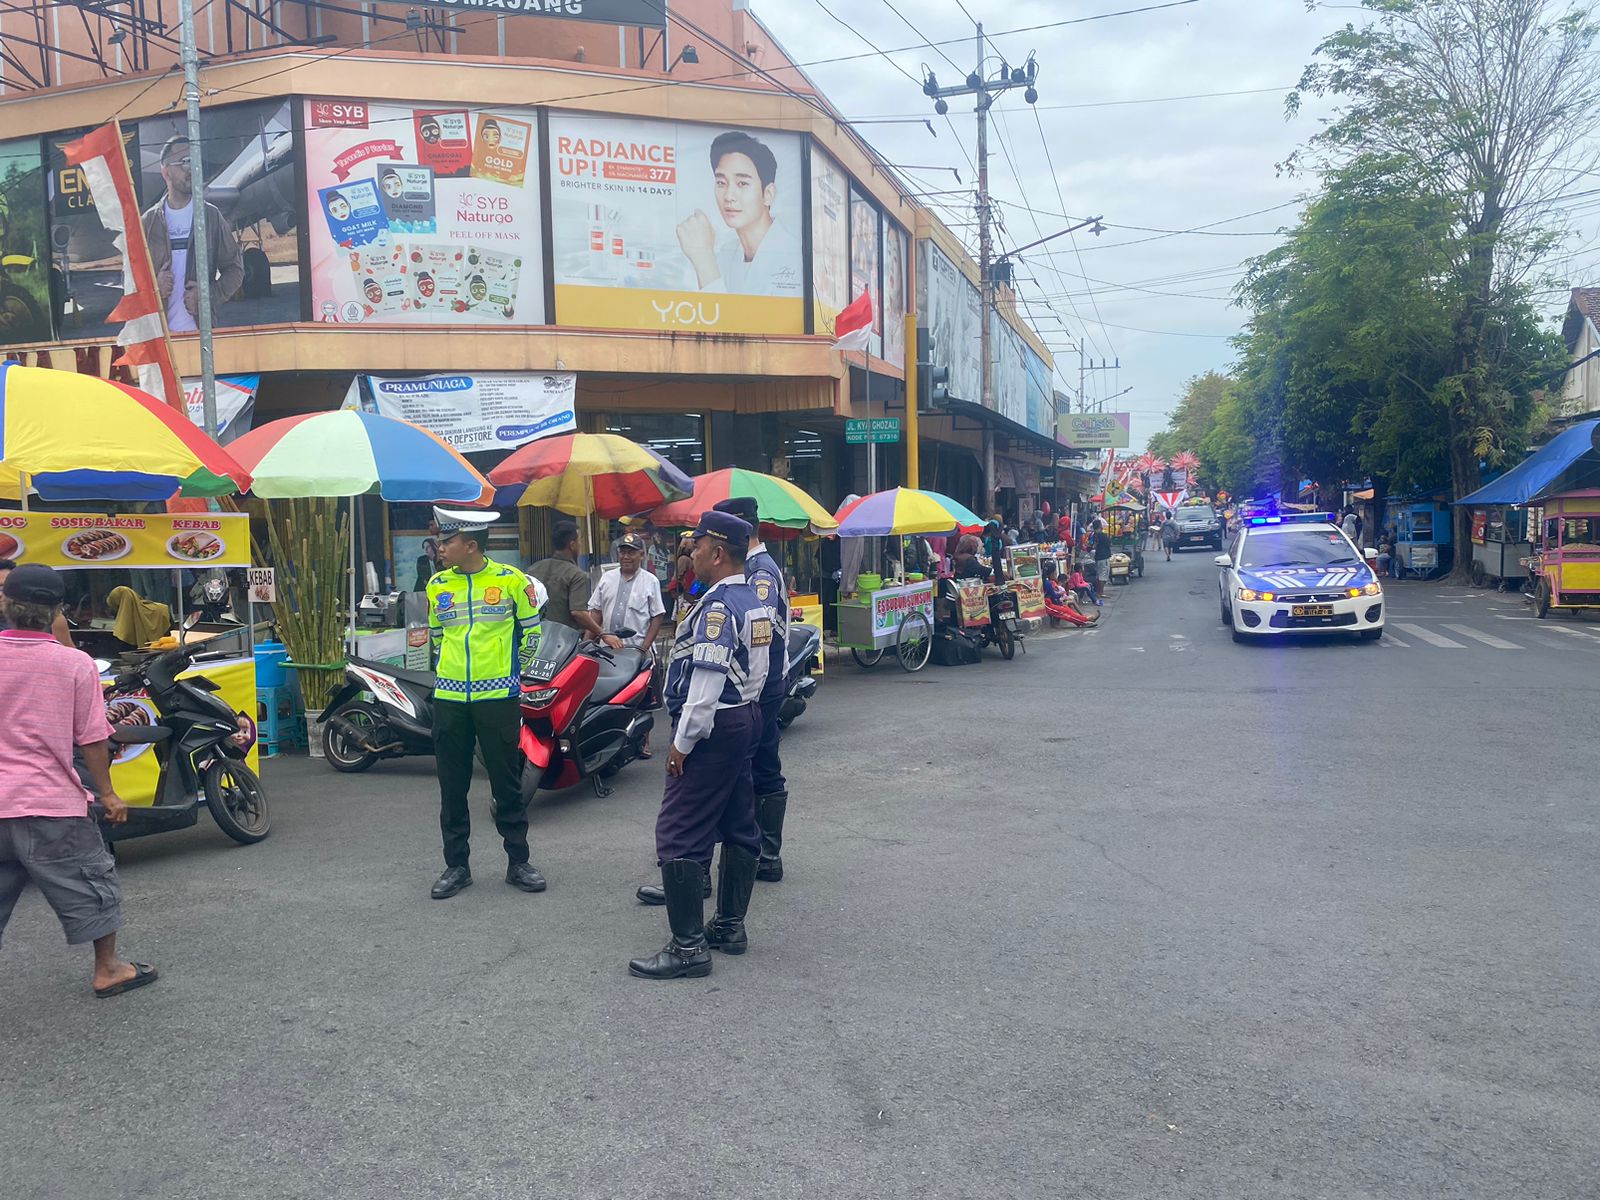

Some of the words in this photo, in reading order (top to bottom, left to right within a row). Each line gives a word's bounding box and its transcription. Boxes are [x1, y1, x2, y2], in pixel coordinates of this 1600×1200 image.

[333, 104, 364, 119] SYB
[558, 136, 675, 163] RADIANCE
[485, 155, 514, 169] GOLD
[559, 157, 597, 177] UP!
[649, 168, 672, 181] 377
[560, 180, 602, 190] BRIGHTER
[604, 184, 624, 192] SKIN
[477, 196, 508, 210] SYB
[456, 210, 513, 223] Naturgo
[342, 224, 362, 233] GOAT
[449, 231, 474, 239] PEEL
[385, 379, 467, 392] PRAMUNIAGA
[872, 420, 898, 431] GHOZALI
[454, 430, 493, 444] DEPSTORE
[50, 517, 94, 528] SOSIS
[95, 517, 146, 530] BAKAR
[172, 519, 222, 531] KEBAB
[249, 570, 273, 586] KEBAB
[1254, 566, 1358, 579] POLISI
